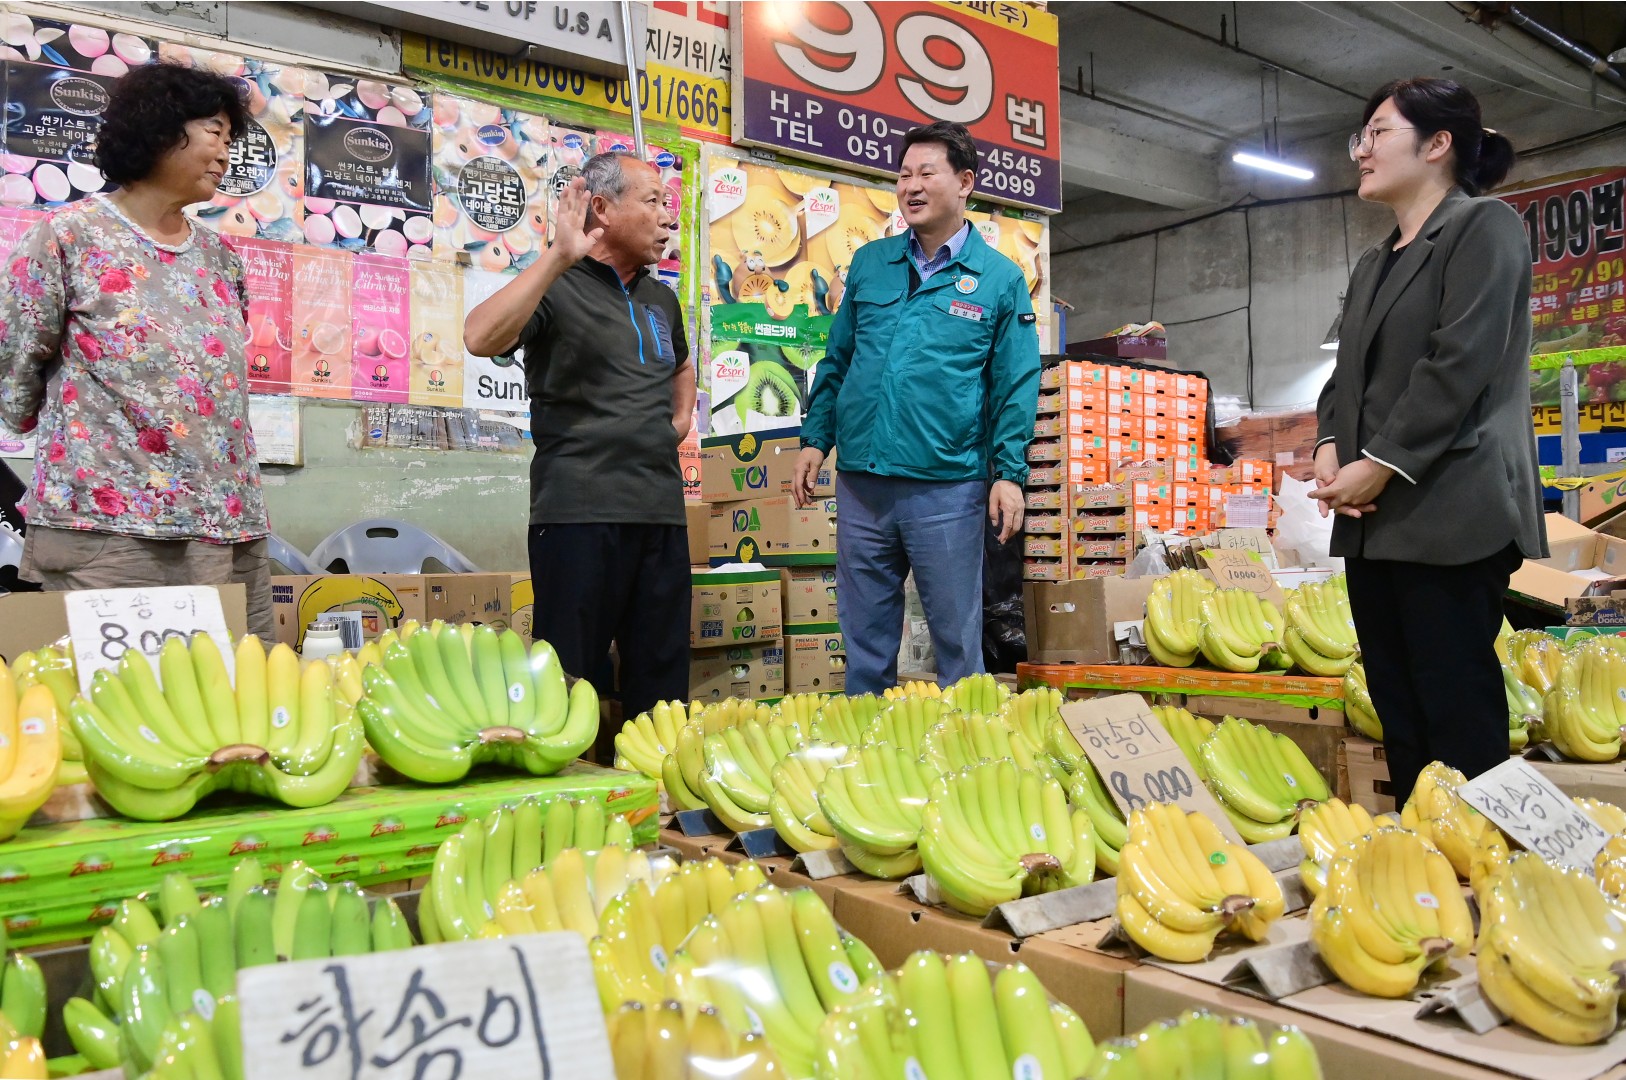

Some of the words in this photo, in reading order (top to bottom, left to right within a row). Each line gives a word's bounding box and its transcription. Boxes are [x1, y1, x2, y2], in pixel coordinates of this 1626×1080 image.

[946, 1, 1028, 28] 파(주)
[54, 86, 107, 104] Sunkist
[770, 90, 824, 120] H.P
[22, 124, 58, 137] 고당도
[346, 136, 391, 152] Sunkist
[769, 115, 823, 148] TEL
[847, 135, 892, 164] 051
[235, 166, 268, 180] 오렌지
[323, 169, 352, 182] 고당도
[237, 180, 254, 189] SWEET
[714, 179, 743, 197] Zespri
[465, 179, 520, 206] 고당도
[465, 199, 493, 214] 네이블
[493, 205, 520, 219] 오렌지
[809, 198, 836, 213] Zespri
[253, 256, 283, 269] Sunkist
[269, 268, 291, 282] Day
[361, 271, 374, 280] My
[375, 273, 401, 283] Sunkist
[354, 279, 387, 292] Citrus
[388, 283, 407, 295] Day
[755, 323, 797, 338] 썬골드키위
[716, 364, 746, 379] Zespri
[1028, 449, 1047, 457] Sweet
[1131, 471, 1151, 479] Sweet
[1090, 495, 1111, 503] Sweet
[824, 501, 837, 512] KO
[733, 507, 761, 533] KOA
[1029, 520, 1048, 528] Sweet
[1089, 519, 1110, 527] Sweet
[1028, 543, 1047, 551] Sweet
[1090, 544, 1111, 552] Sweet
[1028, 566, 1048, 574] Sweet
[1090, 568, 1111, 576] Sweet
[273, 594, 293, 603] PREMIU
[1082, 713, 1161, 759] 한송이
[435, 815, 468, 830] Zespri
[370, 822, 405, 839] Zespri
[302, 832, 339, 847] Zespri
[229, 840, 269, 857] Zespri
